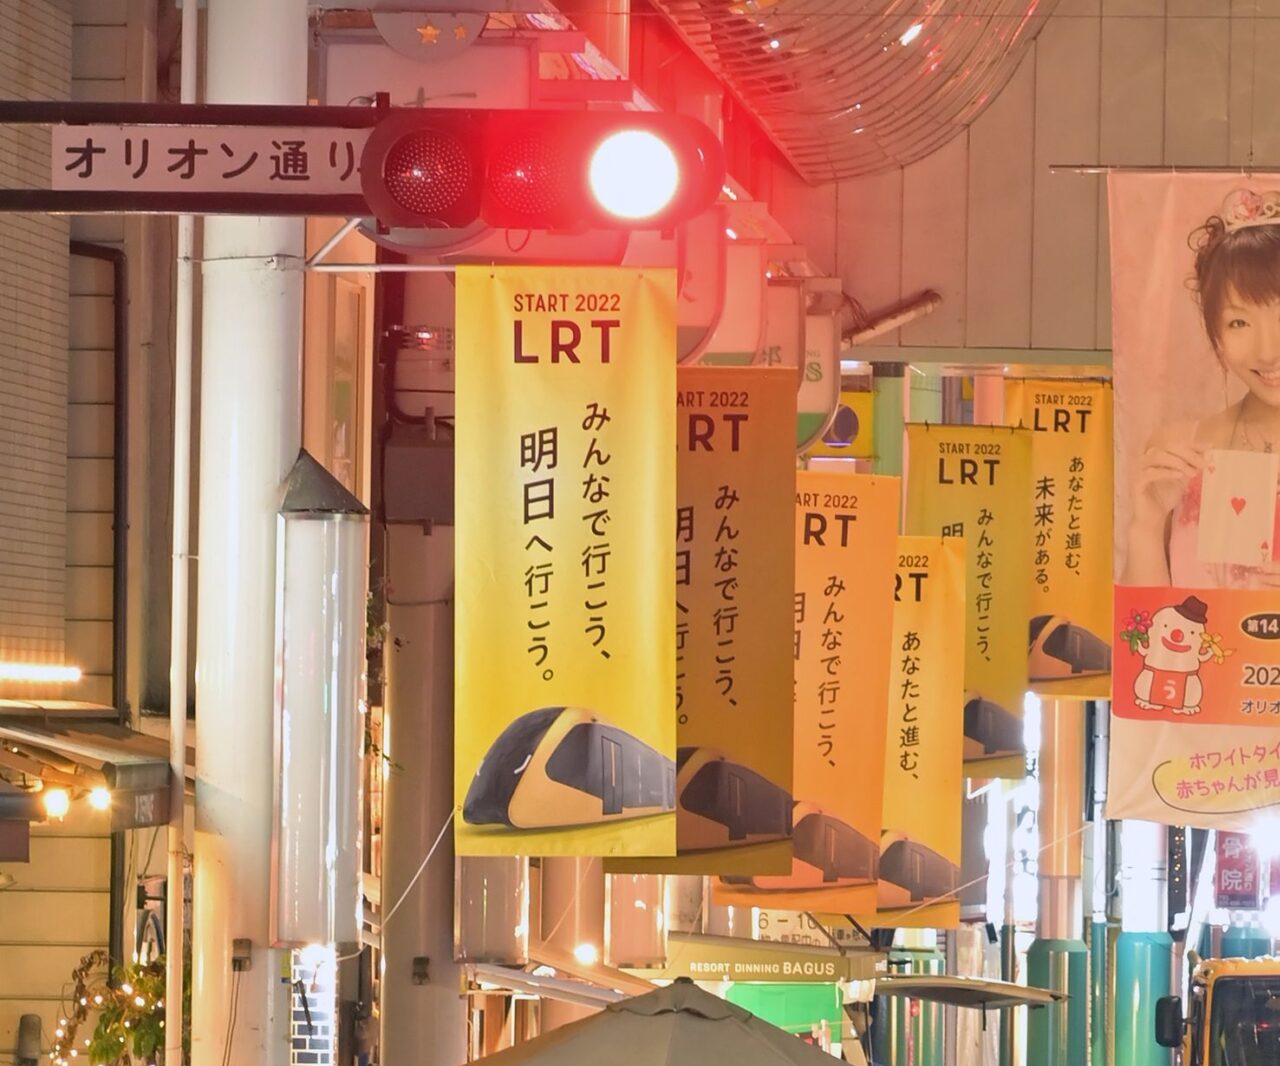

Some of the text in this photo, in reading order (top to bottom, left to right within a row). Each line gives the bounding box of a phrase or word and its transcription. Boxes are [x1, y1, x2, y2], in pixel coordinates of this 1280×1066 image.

[64, 138, 356, 182] オリオン通り
[513, 293, 621, 312] START 2022
[513, 319, 621, 365] LRT
[676, 391, 750, 408] ART 2022
[1034, 394, 1094, 406] START 2022
[676, 413, 750, 453] RT
[1033, 408, 1093, 433] LRT
[938, 442, 1001, 455] START 2022
[938, 457, 1001, 486] LRT
[796, 492, 859, 510] ART 2022
[1064, 456, 1085, 576] あなたと進む、
[581, 402, 612, 660] みんなで行こう、
[802, 512, 858, 548] RT
[1033, 475, 1056, 593] 未来がある。
[520, 426, 558, 682] 明日へ行こう。
[898, 555, 930, 568] 2022
[712, 485, 741, 706] みんなで行こう、
[975, 507, 995, 662] みんなで行こう、
[817, 575, 847, 768] みんなで行こう、
[899, 630, 922, 780] あなたと進む、
[690, 961, 836, 976] RESORT DINNING BAGUS
